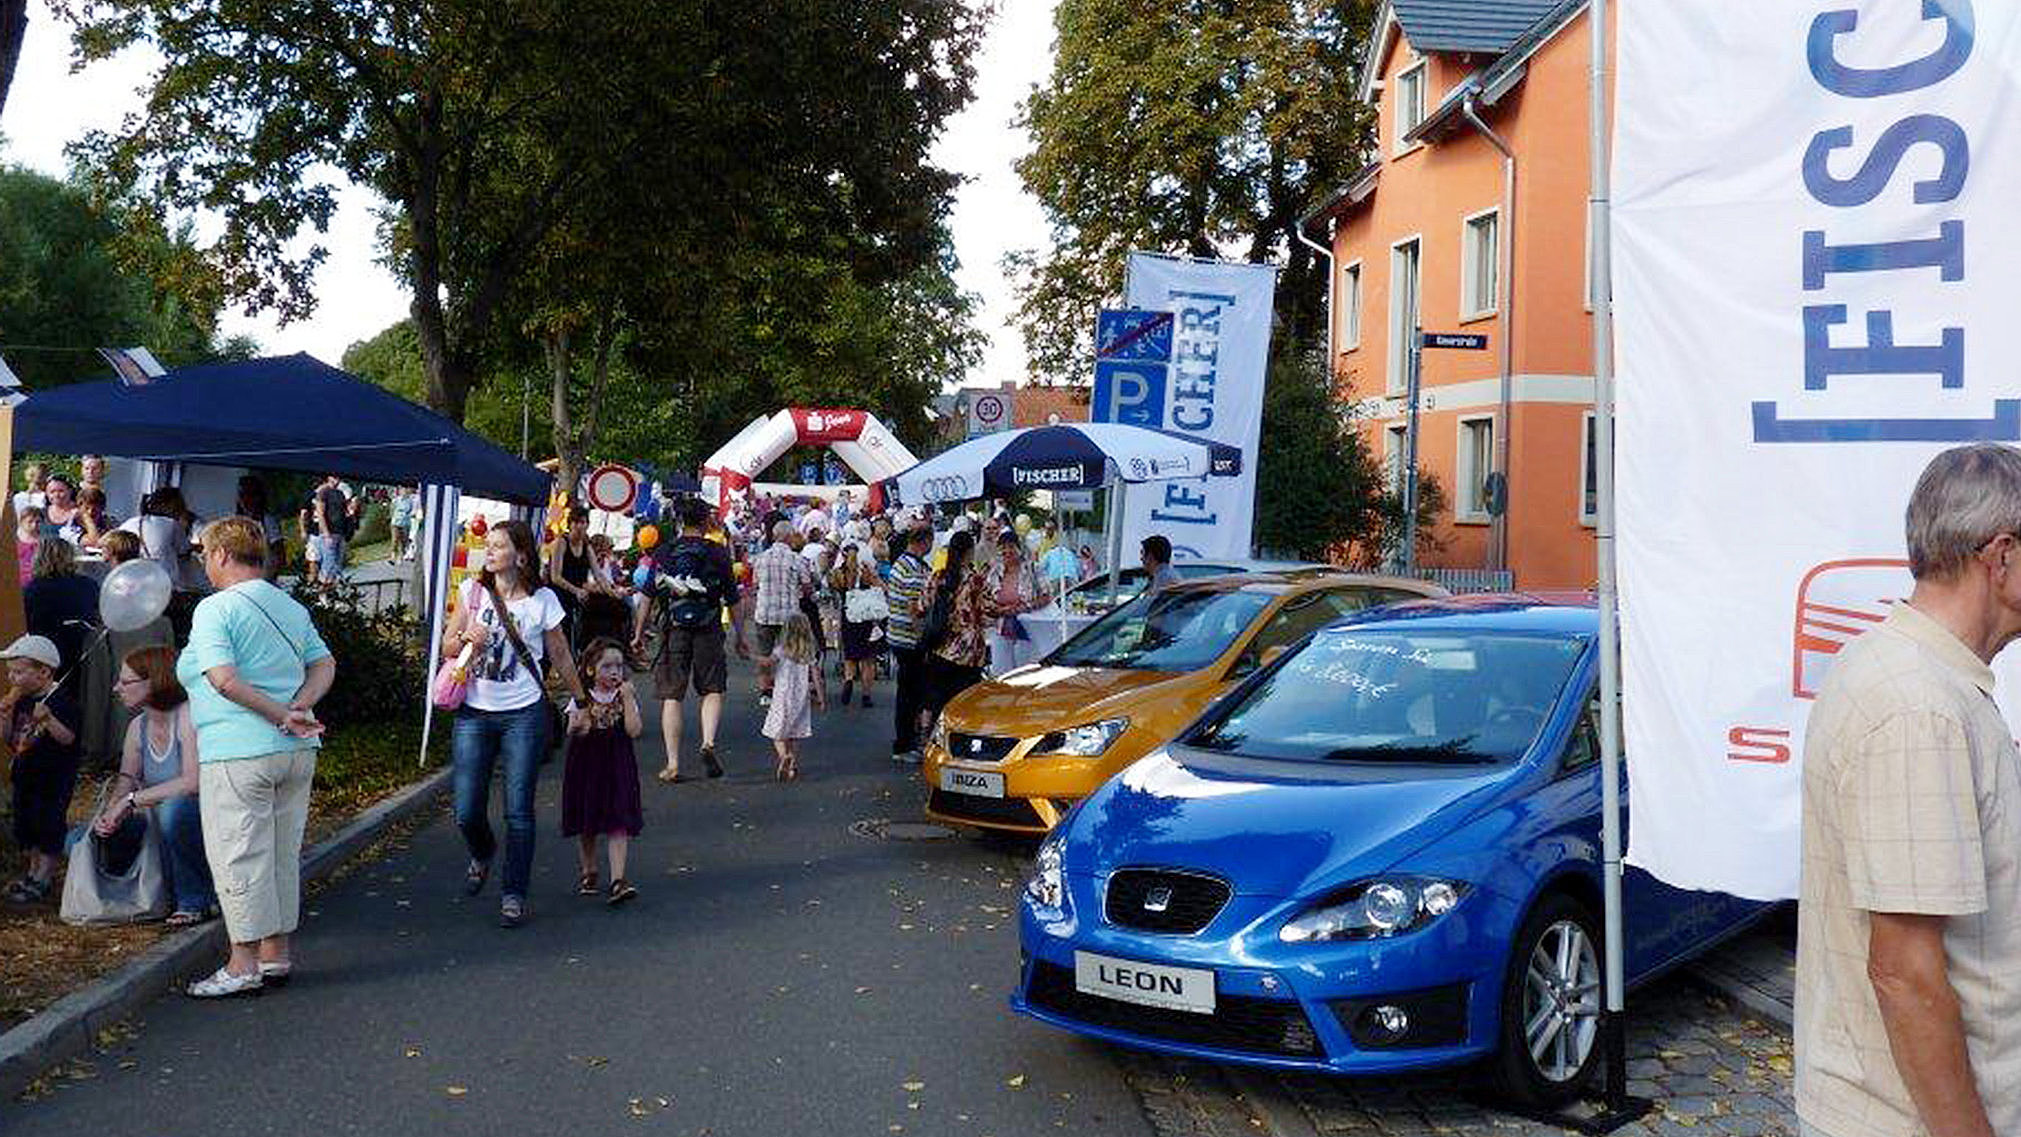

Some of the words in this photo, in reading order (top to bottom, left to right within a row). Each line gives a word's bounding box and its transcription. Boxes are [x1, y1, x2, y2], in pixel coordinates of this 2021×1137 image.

[982, 402, 998, 416] 30
[1109, 370, 1149, 424] P
[1151, 289, 1236, 526] [FCHER]
[950, 770, 989, 789] IBIZA
[1099, 963, 1183, 995] LEON
